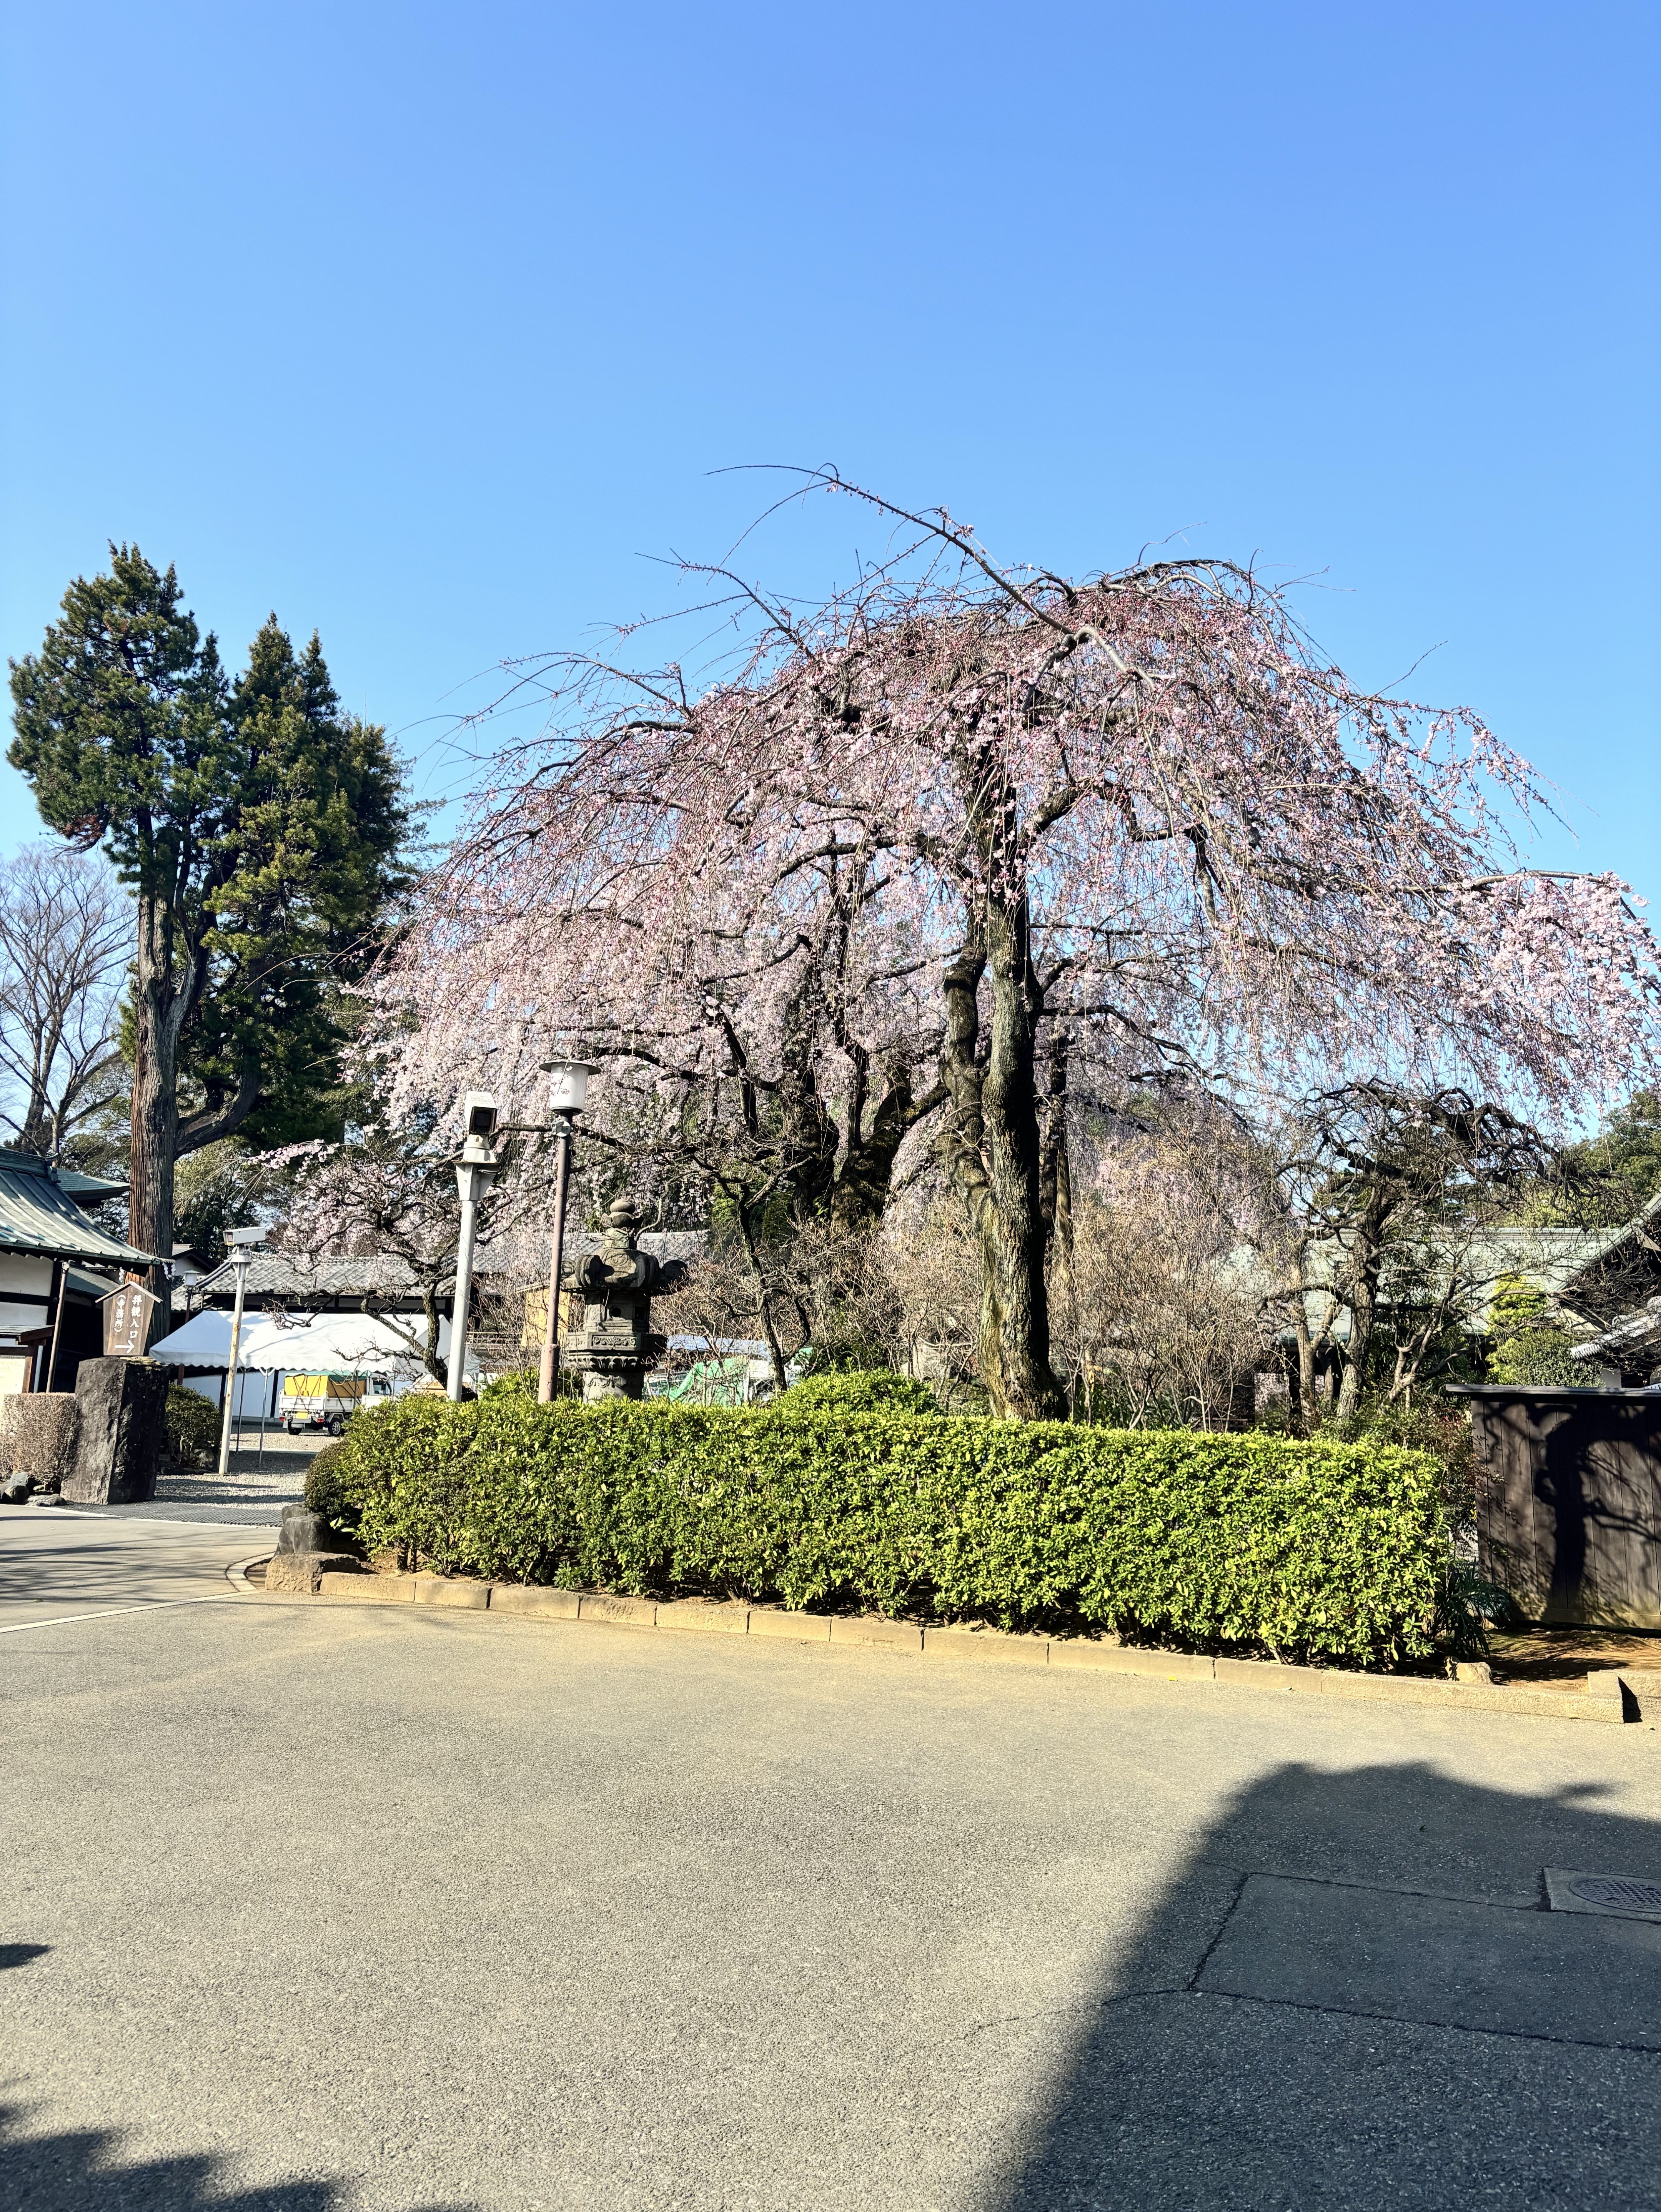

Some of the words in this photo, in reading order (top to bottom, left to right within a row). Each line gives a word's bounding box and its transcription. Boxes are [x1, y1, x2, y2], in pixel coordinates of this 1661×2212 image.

[114, 1294, 126, 1332] （寺務所）
[130, 1295, 143, 1339] 拝観入口
